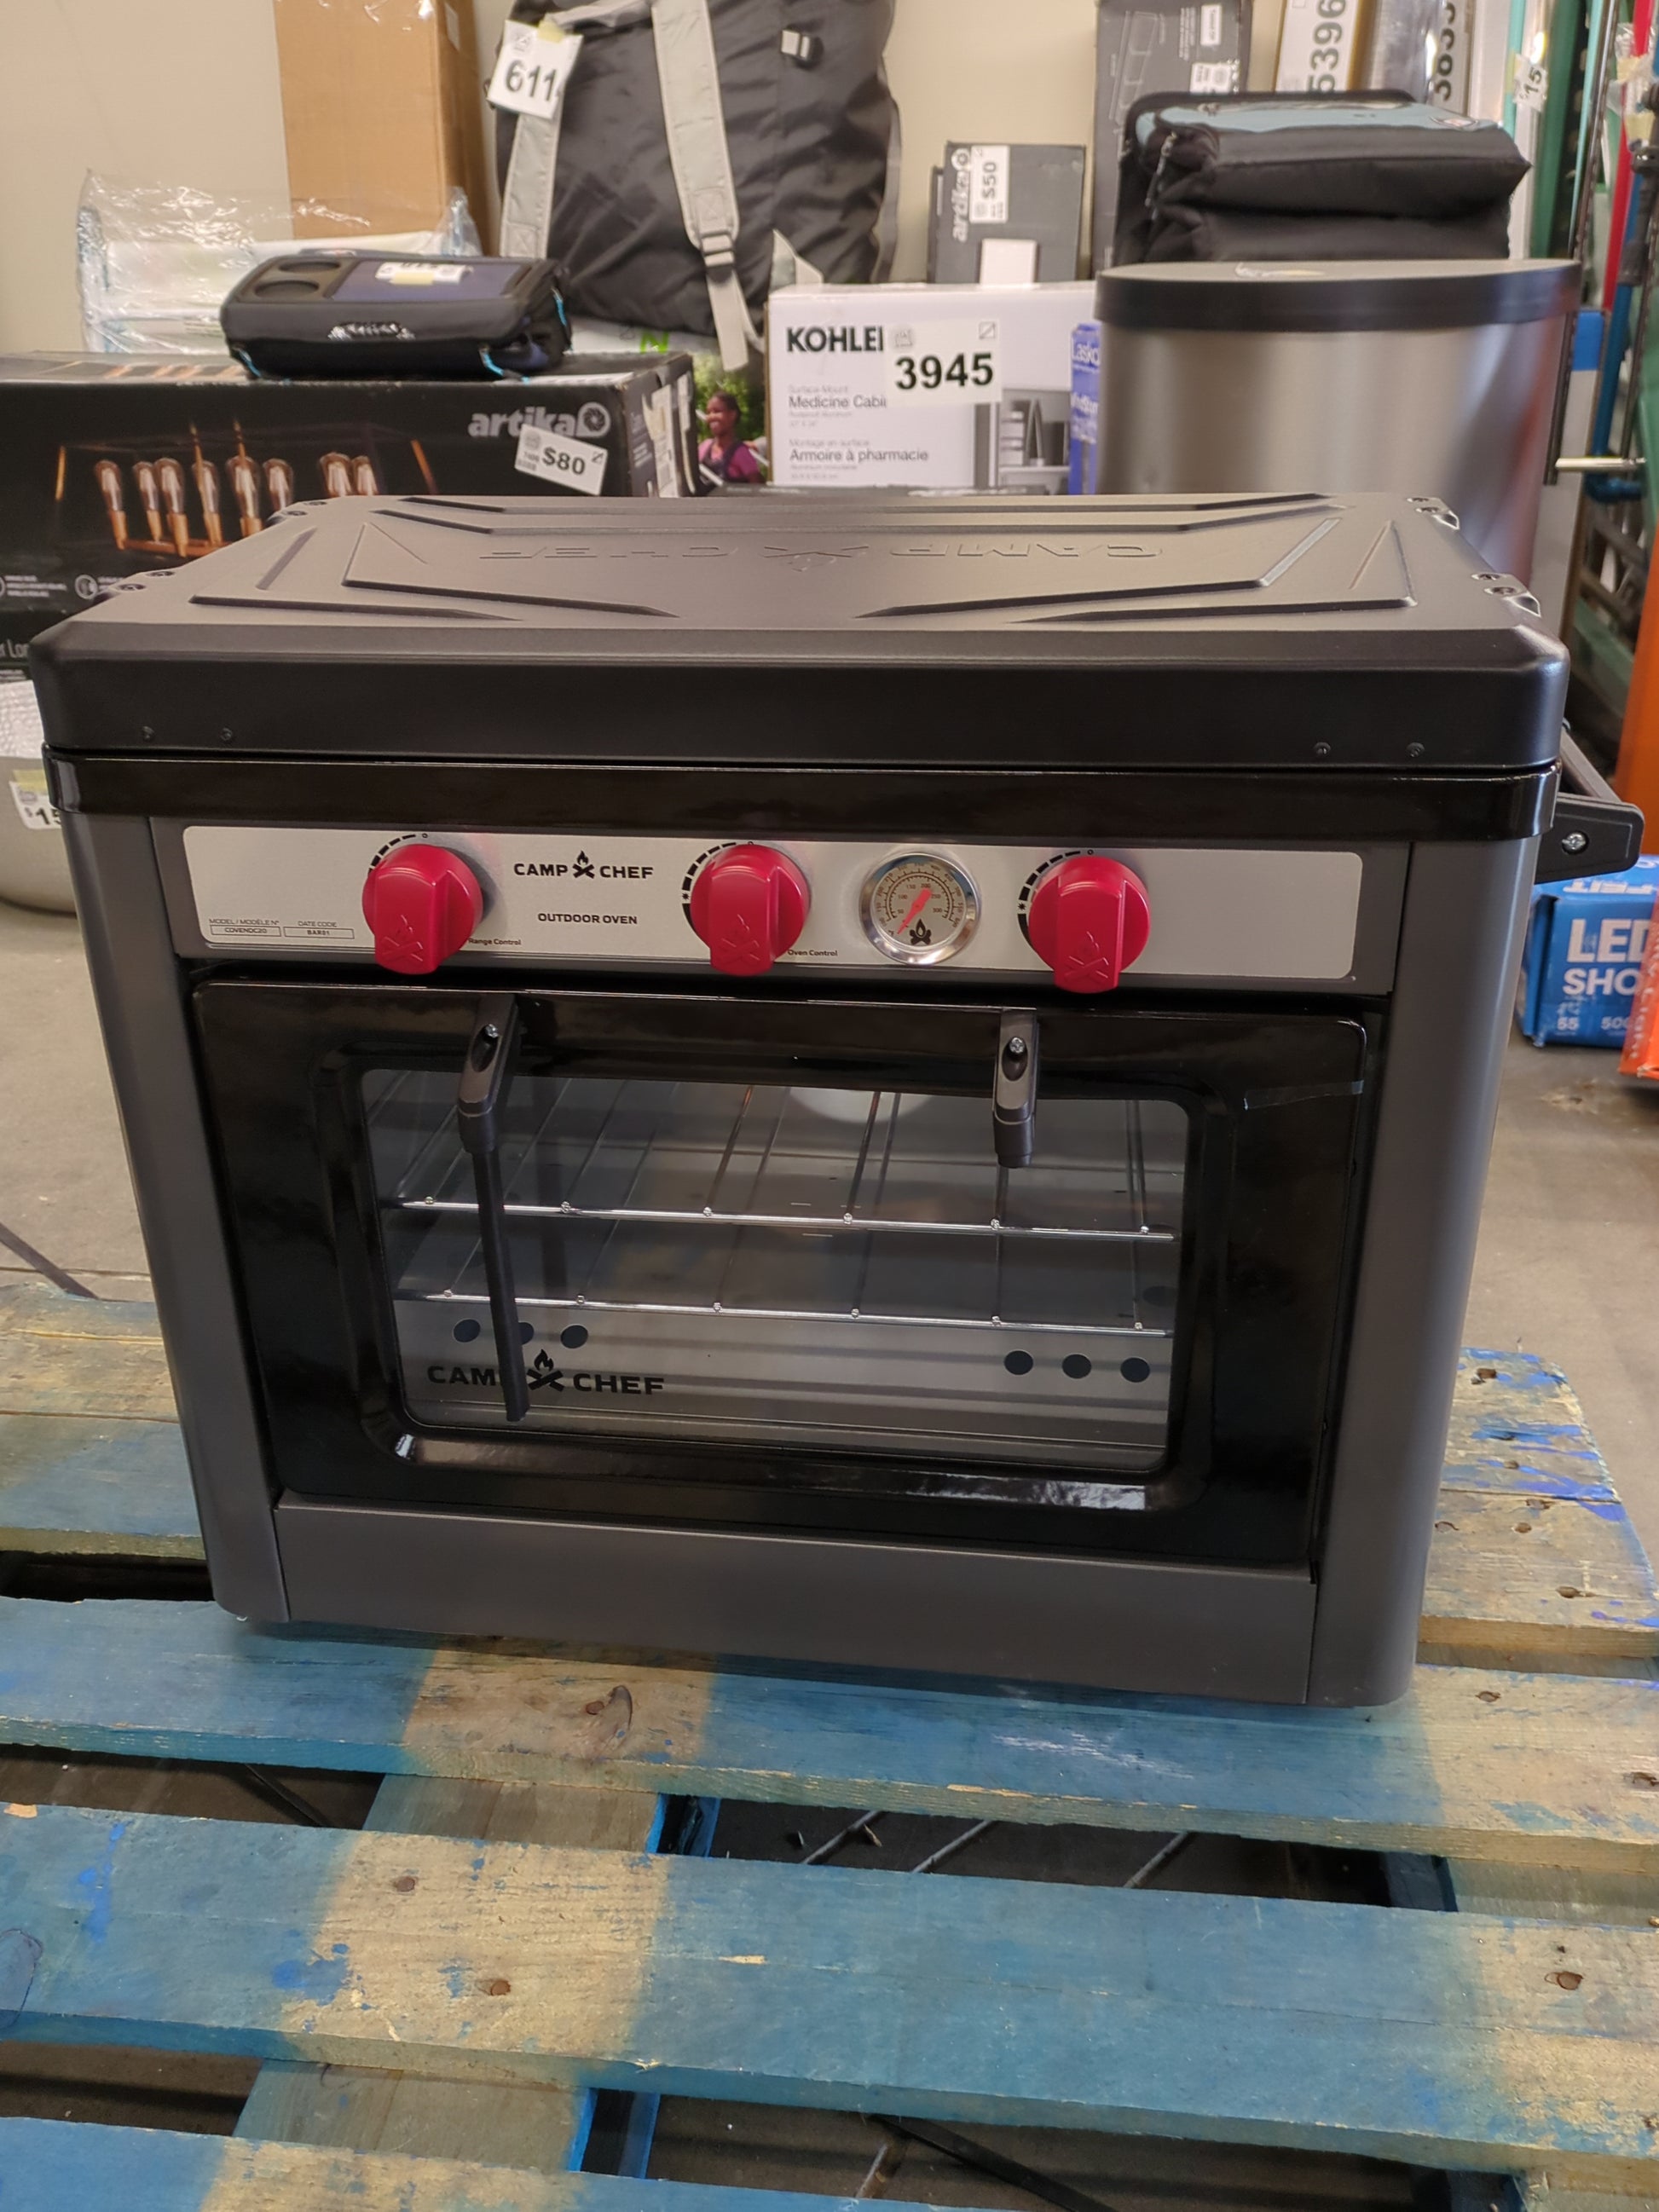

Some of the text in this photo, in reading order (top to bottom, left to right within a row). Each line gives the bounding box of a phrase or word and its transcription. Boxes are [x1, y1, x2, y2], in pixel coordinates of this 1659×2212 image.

[1308, 0, 1347, 92] 5396
[982, 162, 997, 199] $50
[895, 352, 993, 390] 3945
[789, 395, 849, 408] Medicine
[467, 406, 577, 438] artika
[542, 446, 586, 476] $80
[789, 448, 929, 463] Armoire à pharmacie
[514, 863, 655, 879] CAMP CHEF
[538, 913, 638, 924] OUTDOOR OVEN
[427, 1366, 665, 1396] CAM CHEF
